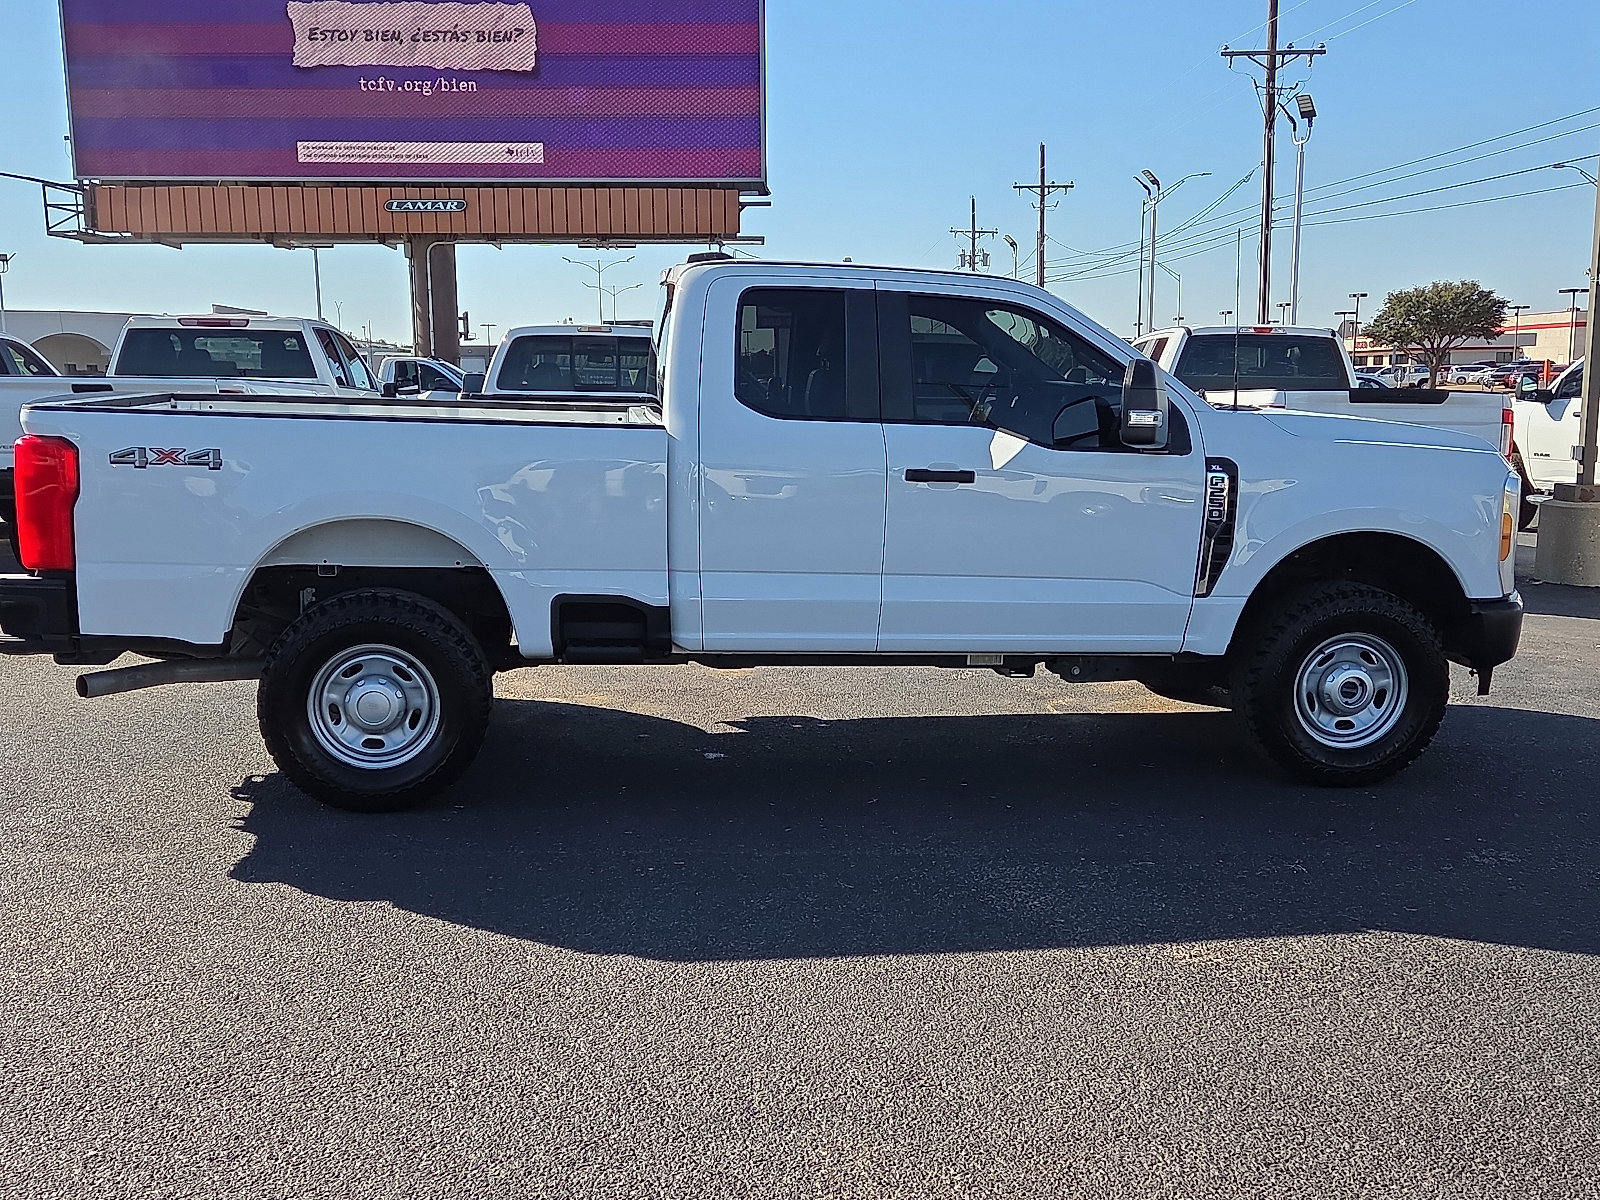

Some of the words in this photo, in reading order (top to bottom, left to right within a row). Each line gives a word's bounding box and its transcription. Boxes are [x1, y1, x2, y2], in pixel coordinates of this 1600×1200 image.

[307, 27, 358, 41] ESTOY
[363, 28, 402, 45] BIEN,
[474, 27, 524, 43] BIEN?
[358, 77, 478, 96] tcfv.org/bien
[391, 201, 458, 210] LAMAR
